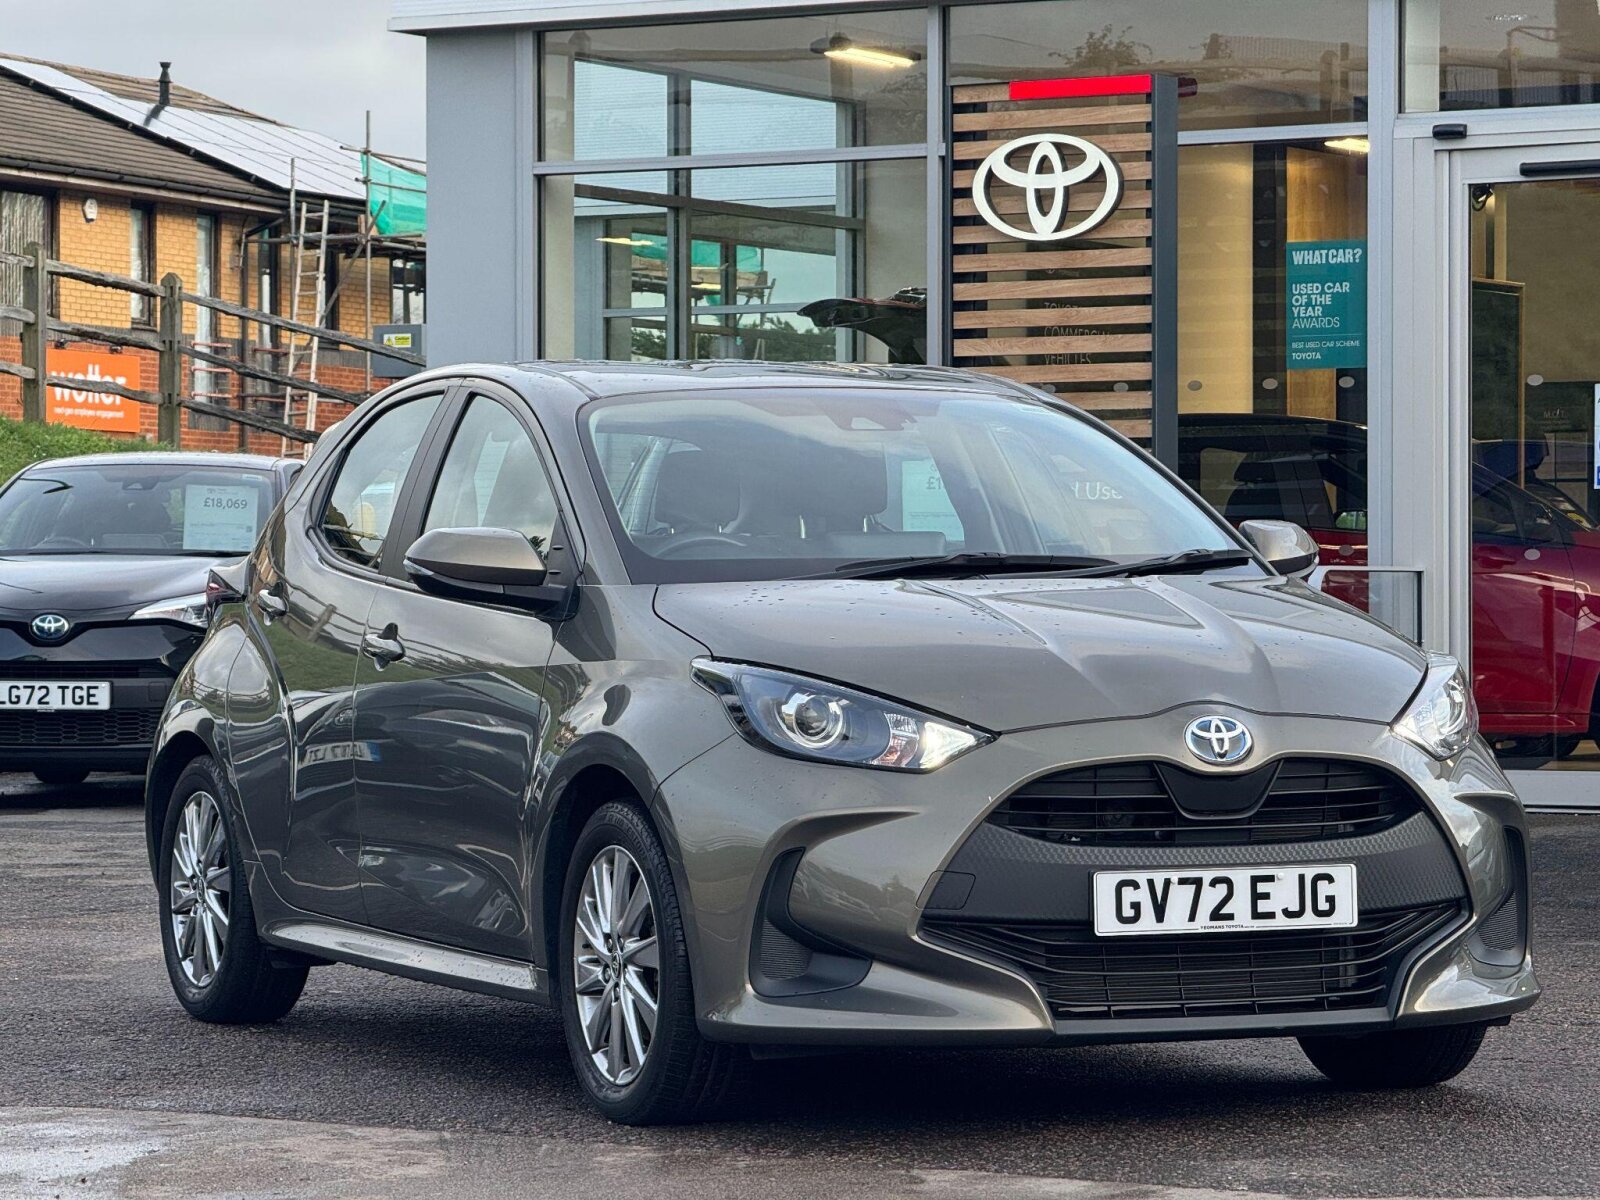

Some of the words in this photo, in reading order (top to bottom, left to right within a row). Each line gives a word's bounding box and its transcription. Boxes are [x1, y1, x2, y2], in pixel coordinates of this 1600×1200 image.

[1292, 249, 1327, 265] WHAT
[1328, 248, 1363, 264] CAR?
[1292, 283, 1322, 294] USED
[1324, 282, 1350, 293] CAR
[1292, 295, 1308, 306] OF
[1311, 294, 1332, 305] THE
[1292, 306, 1323, 317] YEAR
[1292, 317, 1340, 329] AWARDS
[1291, 341, 1304, 349] BEST
[1321, 340, 1335, 348] CAR
[1291, 352, 1321, 360] TOYOTA
[926, 476, 941, 490] £1
[203, 497, 248, 509] £18,069
[57, 686, 99, 705] TGE
[1114, 876, 1235, 925] GV72
[1250, 872, 1336, 920] EJG
